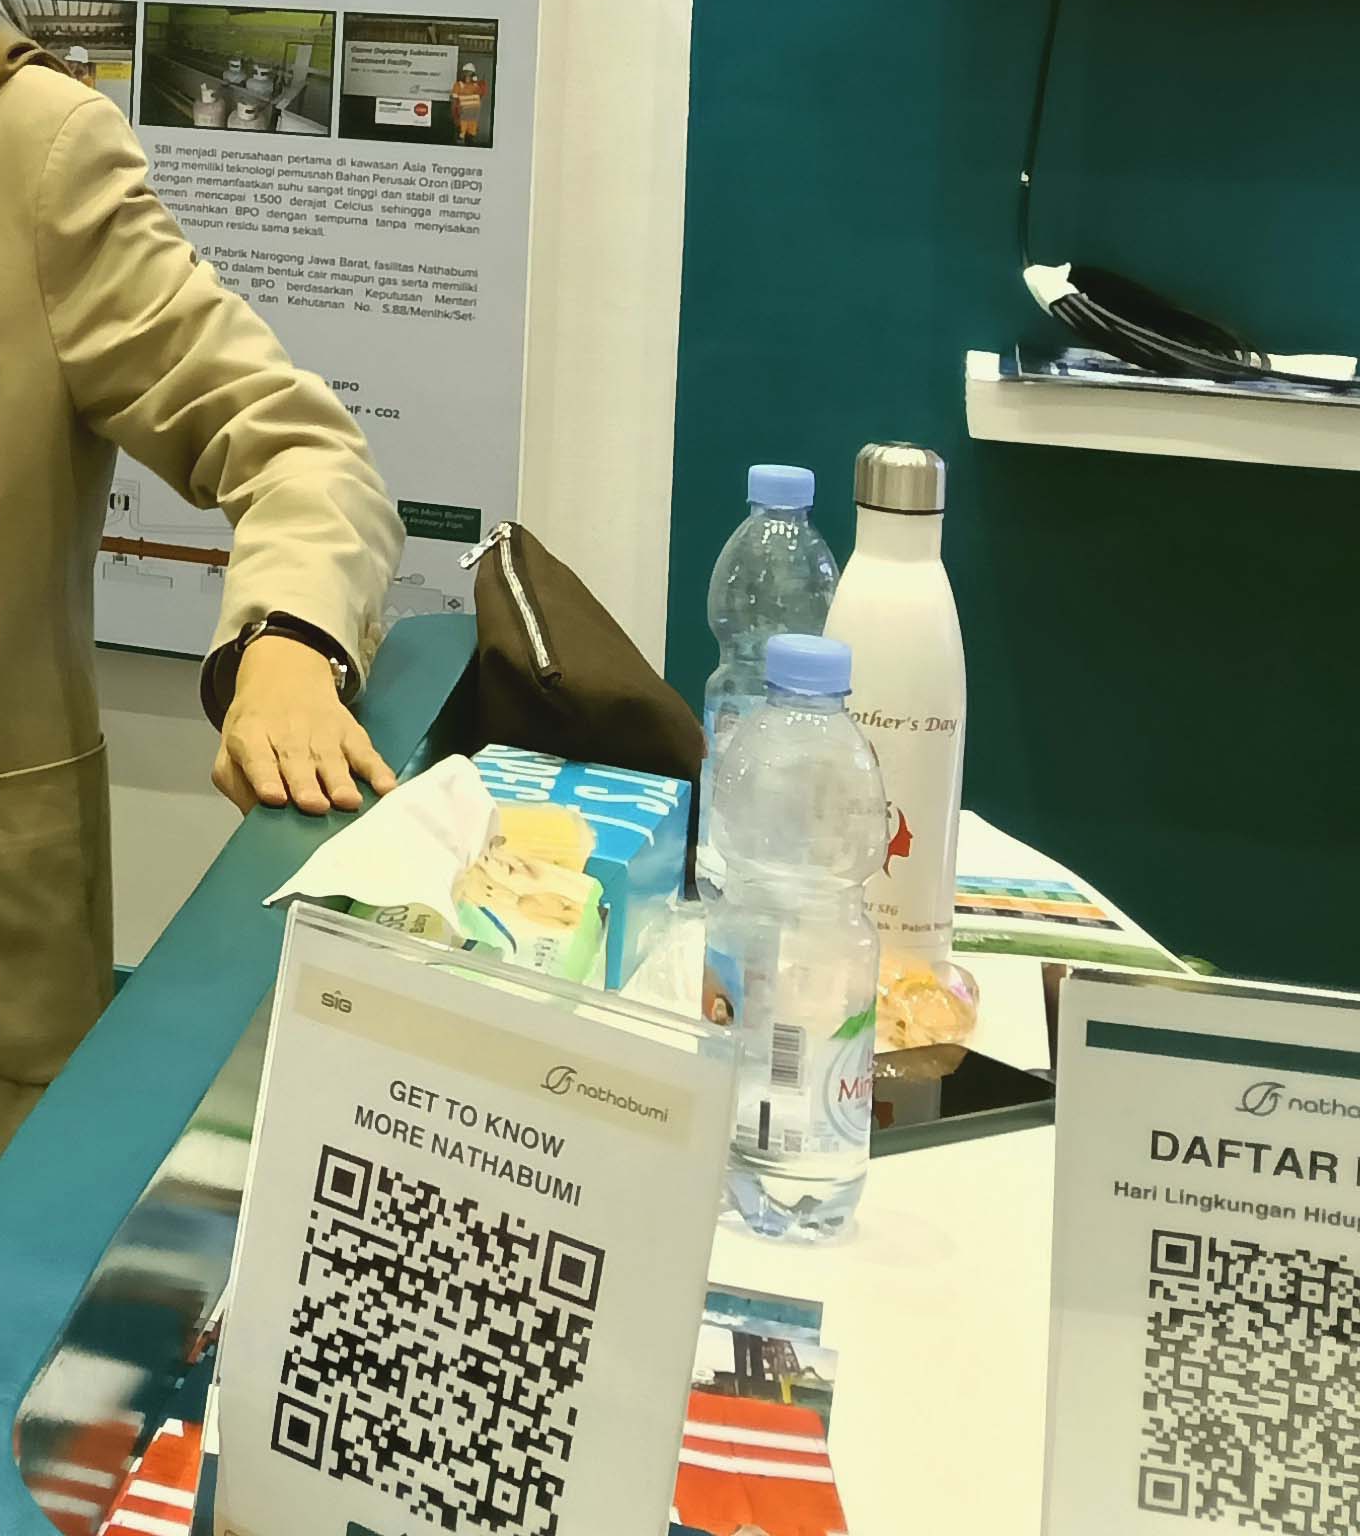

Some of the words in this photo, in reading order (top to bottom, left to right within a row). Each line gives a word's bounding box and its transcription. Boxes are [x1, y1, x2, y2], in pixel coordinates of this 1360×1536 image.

[176, 146, 217, 159] menjadi
[221, 150, 283, 165] perusahaan
[288, 154, 332, 168] pertama
[337, 156, 346, 167] di
[351, 158, 399, 172] kawasan
[403, 161, 426, 173] Asia
[431, 163, 483, 178] Tenggara
[845, 708, 918, 732] other's
[924, 717, 957, 736] Day
[321, 990, 352, 1014] SIG
[389, 1080, 439, 1114] GET
[445, 1098, 478, 1127] TO
[485, 1109, 565, 1158] KNOW
[576, 1082, 668, 1123] nathabumi
[354, 1105, 424, 1149] MORE
[431, 1130, 582, 1206] NATHABUMI
[1150, 1130, 1337, 1184] DAFTAR
[1114, 1182, 1157, 1202] Hari
[1165, 1187, 1295, 1221] Lingkungan
